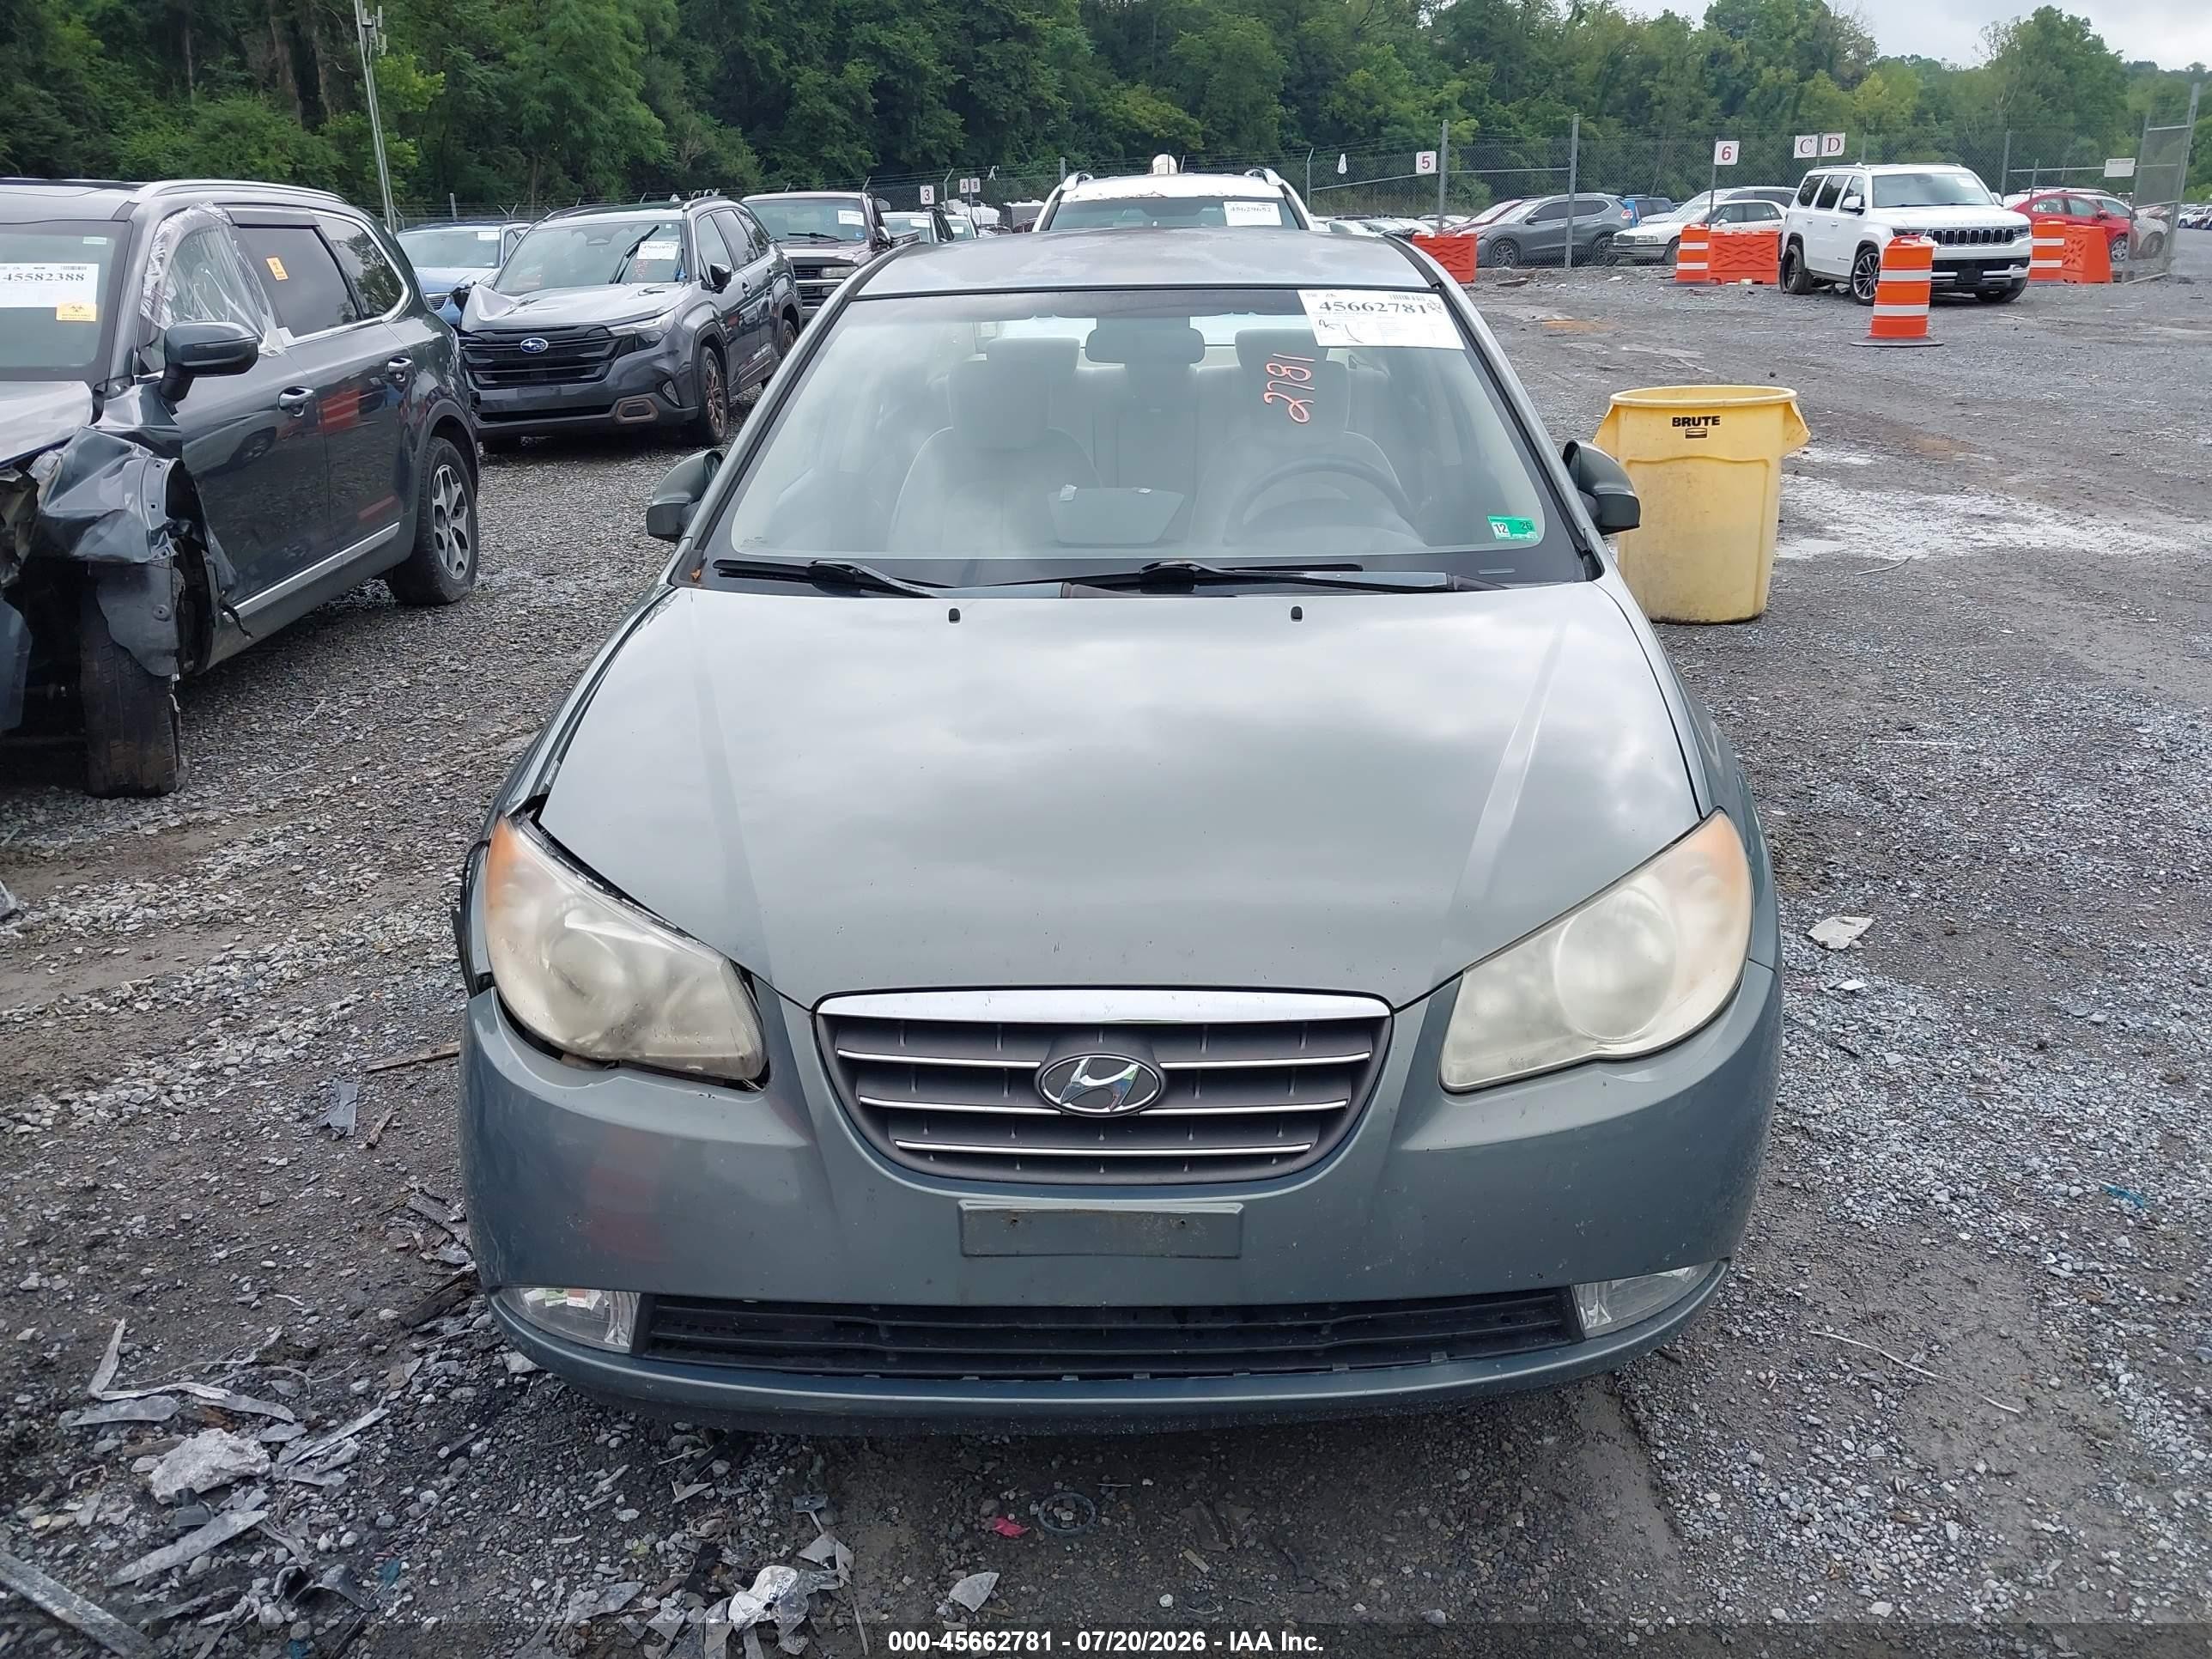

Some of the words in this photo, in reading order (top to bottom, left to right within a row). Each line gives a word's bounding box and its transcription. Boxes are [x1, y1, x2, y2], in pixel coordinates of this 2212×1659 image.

[1799, 138, 1813, 154] C
[1826, 137, 1841, 153] D
[1721, 145, 1732, 161] 6
[1421, 155, 1431, 170] 5
[924, 189, 931, 201] 3
[3, 272, 85, 282] 45582388
[1318, 301, 1428, 314] 45662781
[1263, 353, 1316, 423] 2781
[1671, 416, 1721, 428] BRUTE
[1493, 522, 1509, 534] 12
